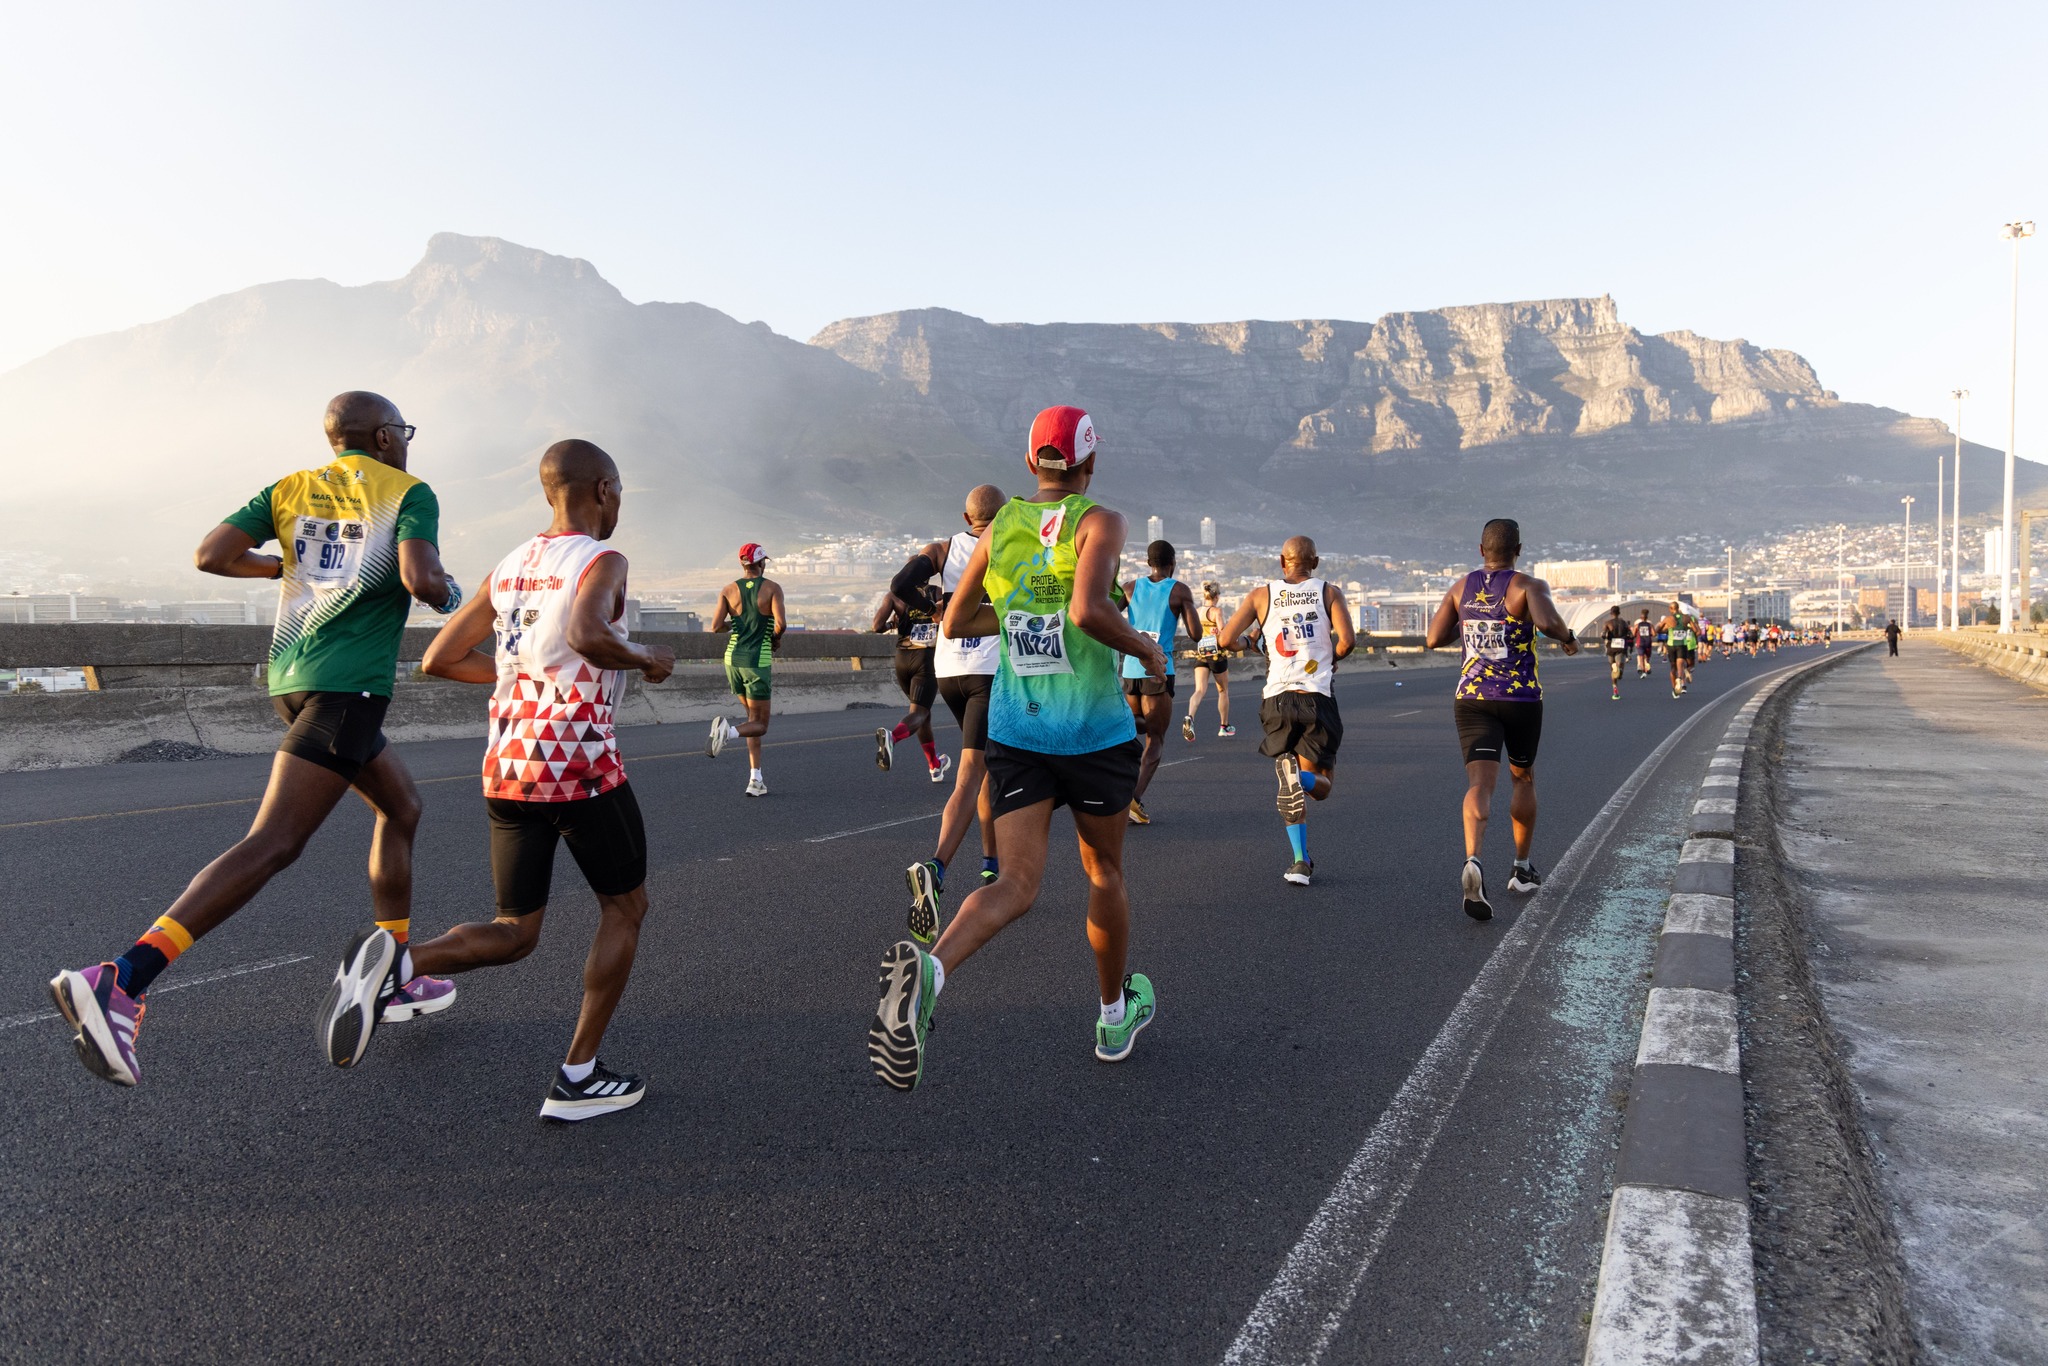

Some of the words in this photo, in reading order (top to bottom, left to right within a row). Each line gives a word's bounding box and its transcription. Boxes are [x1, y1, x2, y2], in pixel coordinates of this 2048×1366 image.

[311, 493, 361, 504] MARNATHA
[302, 529, 316, 537] 2023
[343, 525, 362, 534] ASA
[295, 539, 306, 563] P
[320, 543, 346, 570] 972
[1030, 574, 1058, 585] PROTEA
[1034, 585, 1065, 596] STRIDERS
[1279, 590, 1317, 599] Sibanye
[1273, 597, 1319, 608] Stillwater
[1282, 627, 1289, 640] P
[1294, 623, 1314, 639] 319
[1014, 631, 1062, 658] 10220
